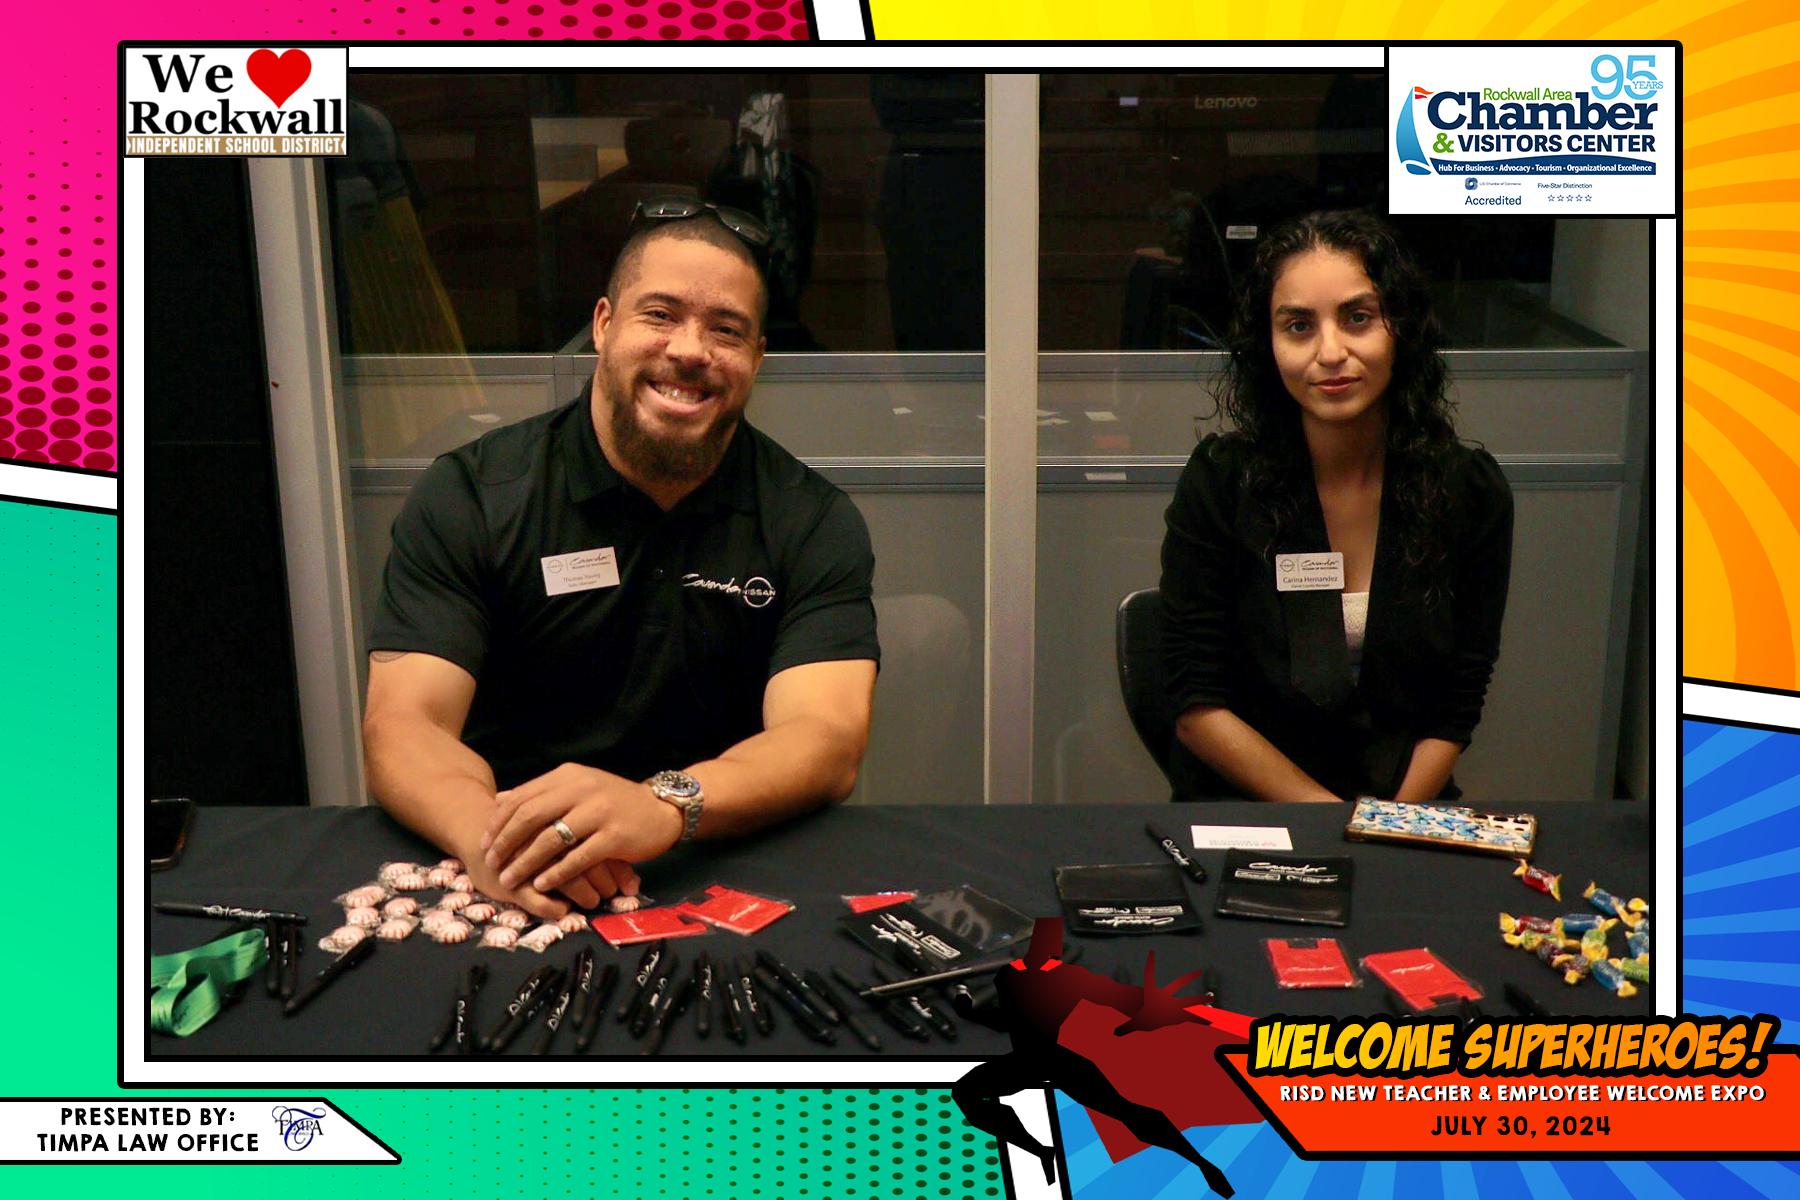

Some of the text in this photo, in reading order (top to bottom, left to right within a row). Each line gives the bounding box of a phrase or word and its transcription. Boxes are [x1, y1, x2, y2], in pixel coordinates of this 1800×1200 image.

[1194, 96, 1257, 109] Lenovo
[1283, 575, 1338, 584] Carina Hernandez
